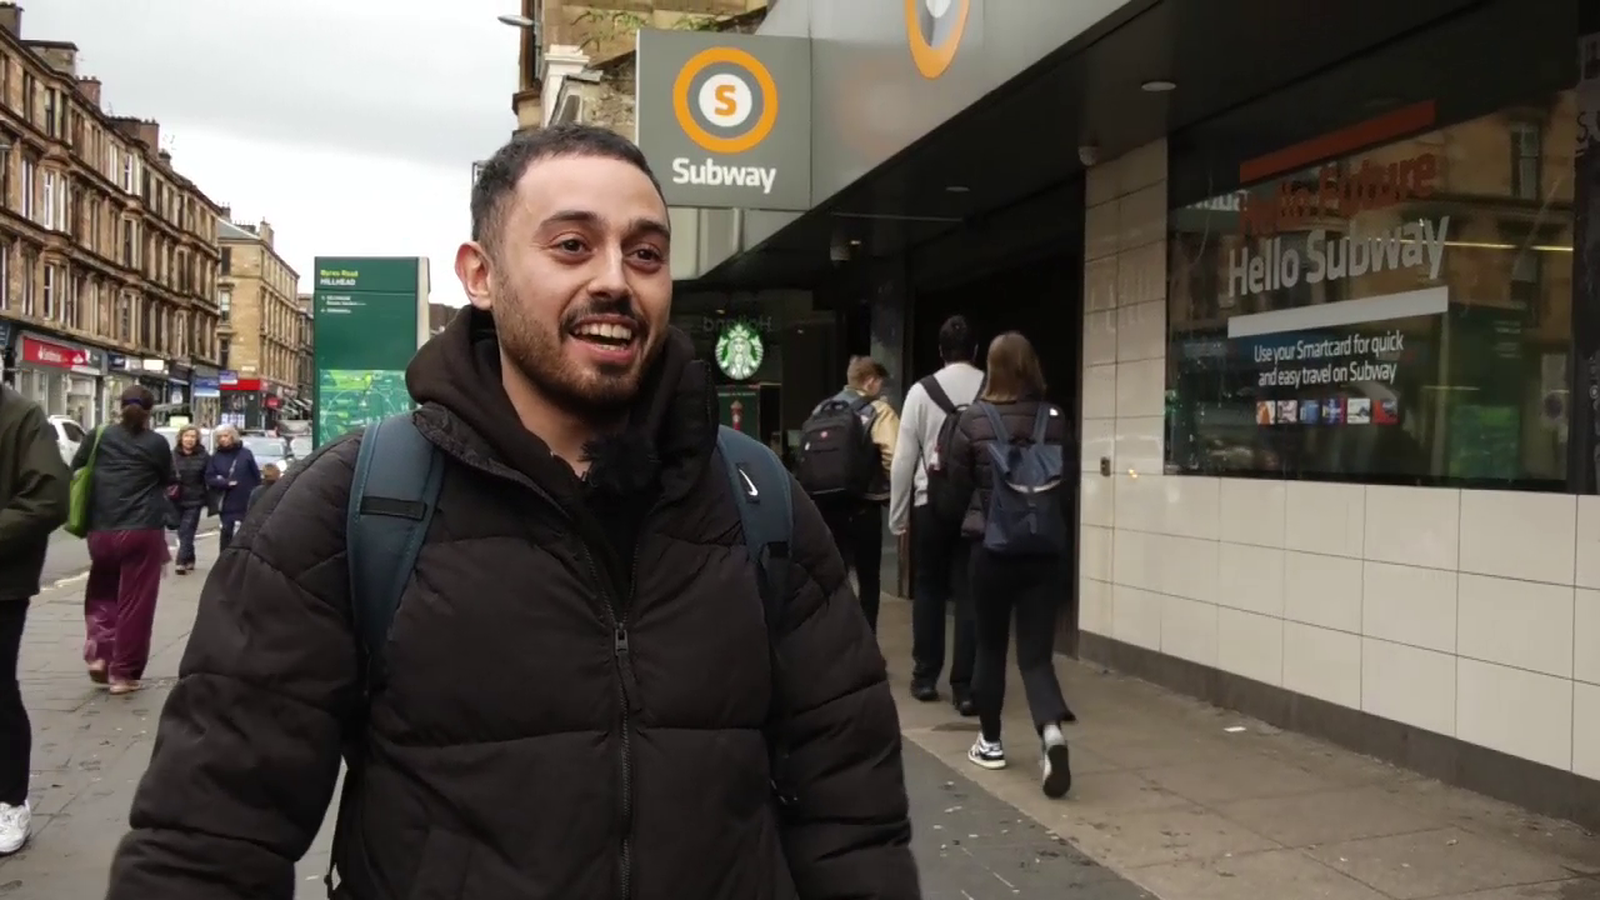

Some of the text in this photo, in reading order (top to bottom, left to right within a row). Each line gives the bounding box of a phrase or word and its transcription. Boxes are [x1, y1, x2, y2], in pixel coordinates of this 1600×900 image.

[714, 84, 738, 116] S
[672, 157, 777, 195] Subway
[1228, 215, 1450, 299] Hello Subway
[320, 278, 356, 286] HILLHEAD
[1254, 330, 1404, 365] Use your Smartcard for quick
[1258, 361, 1398, 389] and easy travel on Subway
